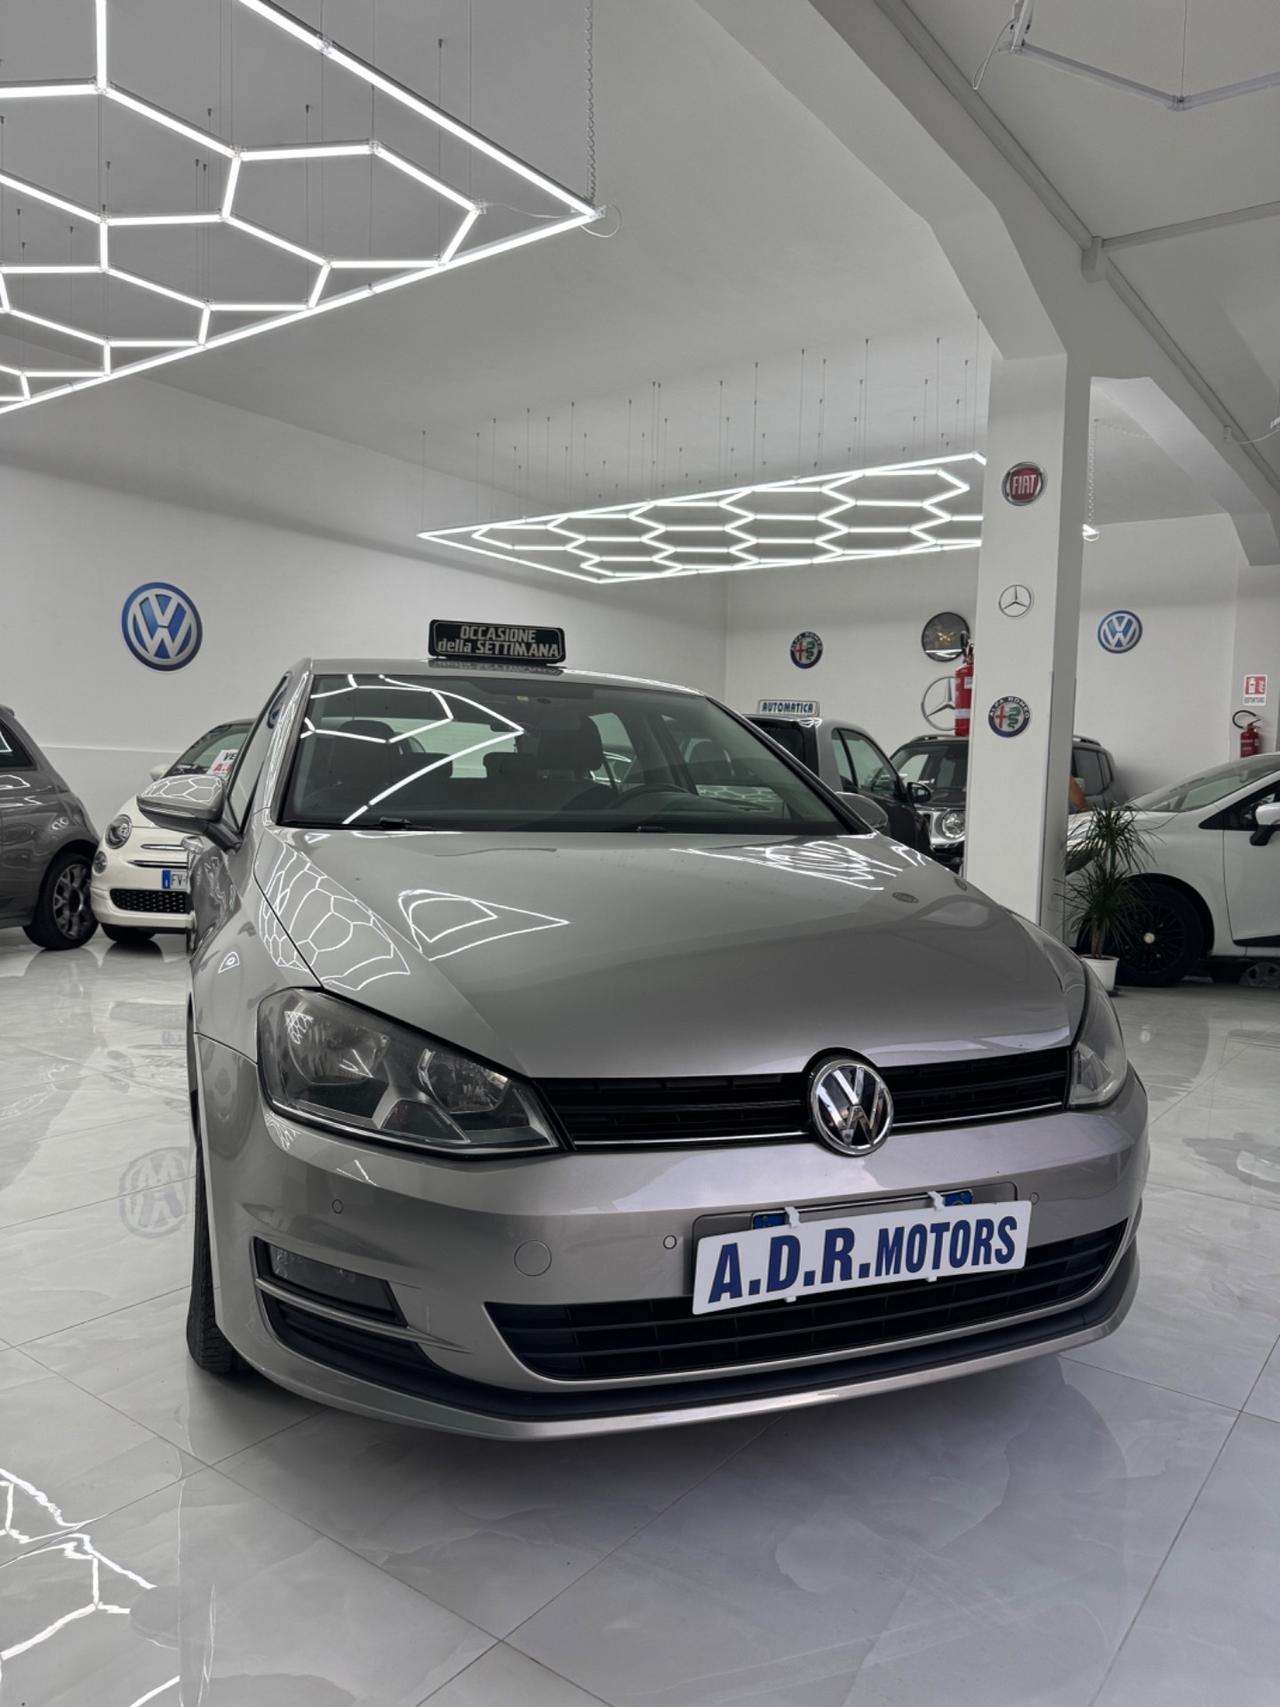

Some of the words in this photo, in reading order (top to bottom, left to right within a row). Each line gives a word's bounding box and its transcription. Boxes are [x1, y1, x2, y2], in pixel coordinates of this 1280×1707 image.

[1012, 474, 1037, 495] FIAT
[460, 625, 537, 643] OCCASIONE
[438, 638, 472, 653] della
[475, 640, 560, 657] SETTIMANA
[761, 702, 814, 713] AUTOMATICA
